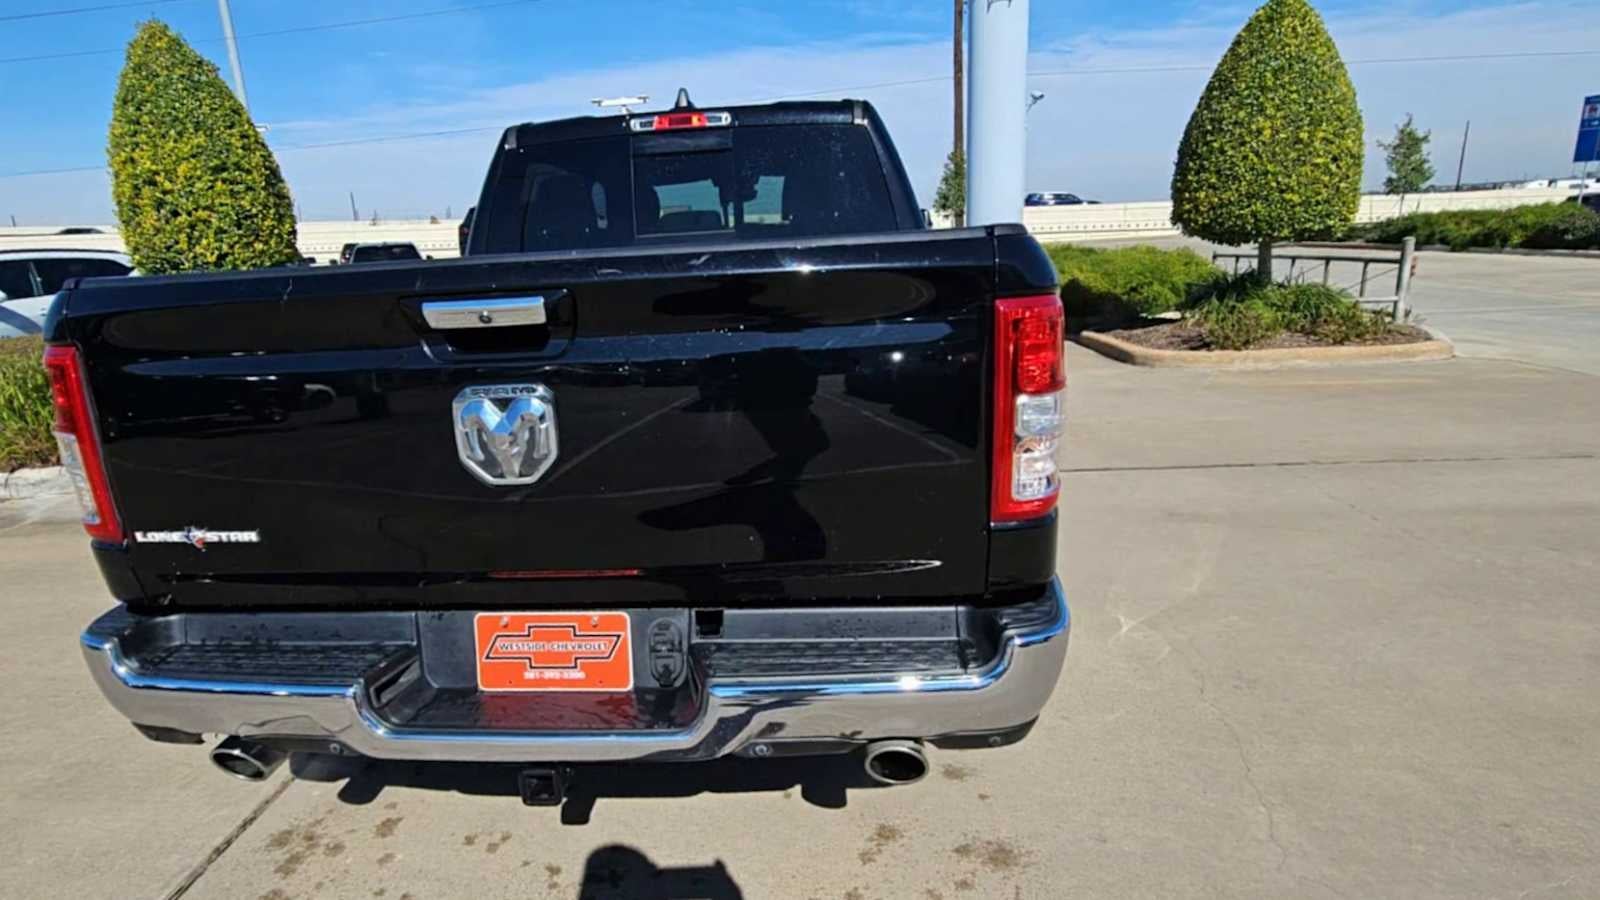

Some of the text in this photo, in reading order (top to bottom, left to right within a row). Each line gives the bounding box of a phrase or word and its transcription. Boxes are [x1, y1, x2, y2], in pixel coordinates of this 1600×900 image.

[471, 386, 537, 396] RAM
[134, 530, 259, 543] LONE STAR
[499, 642, 609, 652] WESTSIDE CHEVROLET
